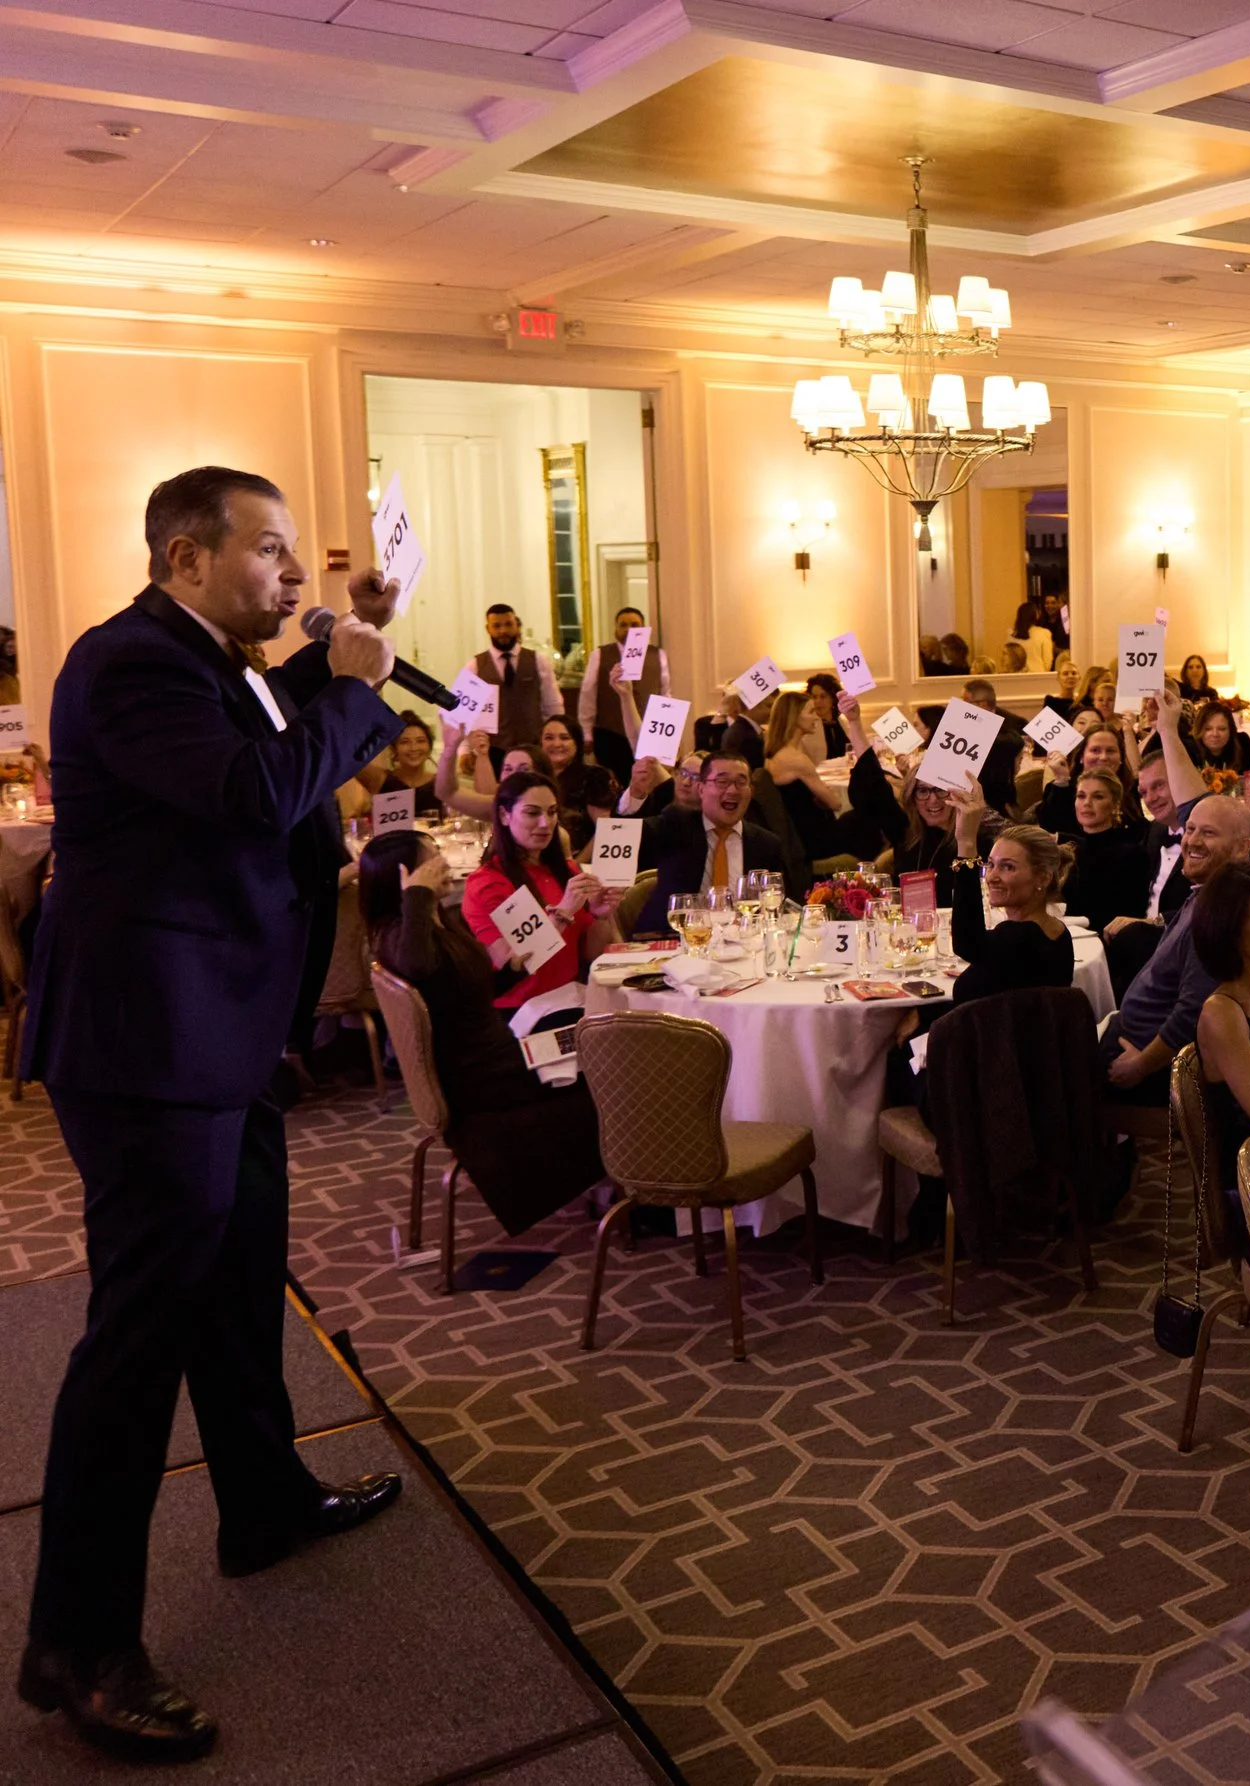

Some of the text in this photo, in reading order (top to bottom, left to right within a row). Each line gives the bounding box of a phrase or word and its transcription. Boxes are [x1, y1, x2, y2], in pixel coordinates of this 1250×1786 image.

[519, 311, 558, 340] EXIT
[626, 647, 643, 658] 204
[1126, 652, 1158, 667] 307
[839, 655, 860, 673] 309
[750, 671, 770, 692] 301
[648, 720, 675, 737] 310
[884, 721, 909, 743] 1009
[1039, 720, 1066, 744] 1001
[939, 731, 980, 761] 304
[379, 809, 409, 824] 202
[599, 845, 632, 858] 208
[511, 914, 543, 944] 302
[835, 934, 849, 952] 3
